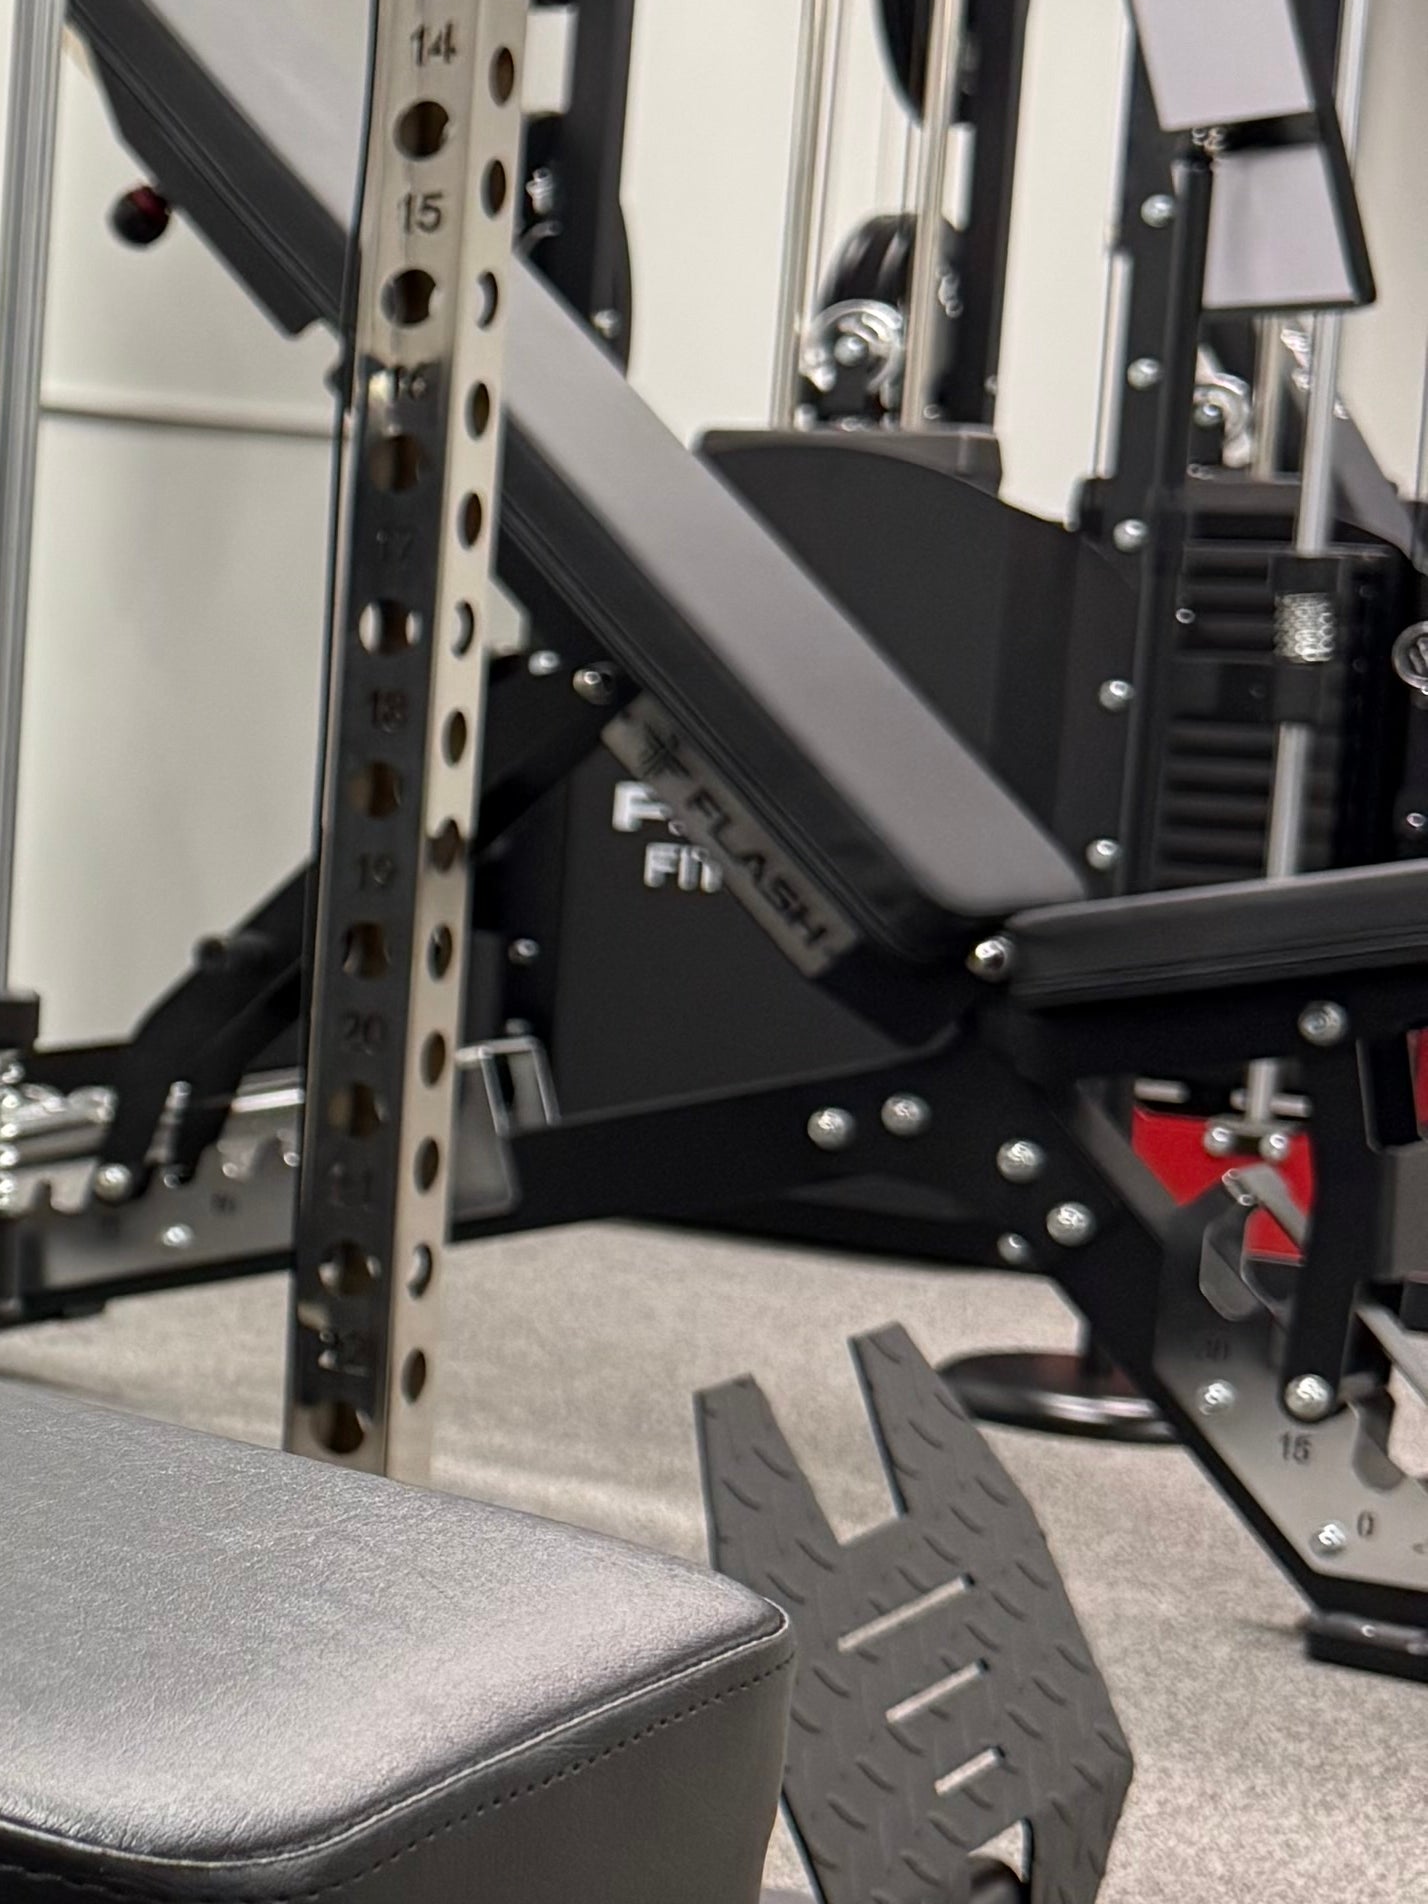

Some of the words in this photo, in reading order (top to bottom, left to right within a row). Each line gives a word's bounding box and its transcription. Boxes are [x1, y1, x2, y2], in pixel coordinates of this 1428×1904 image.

[409, 23, 457, 66] 14
[398, 193, 444, 234] 15
[342, 1014, 387, 1055] 20
[1357, 1510, 1375, 1538] 0
